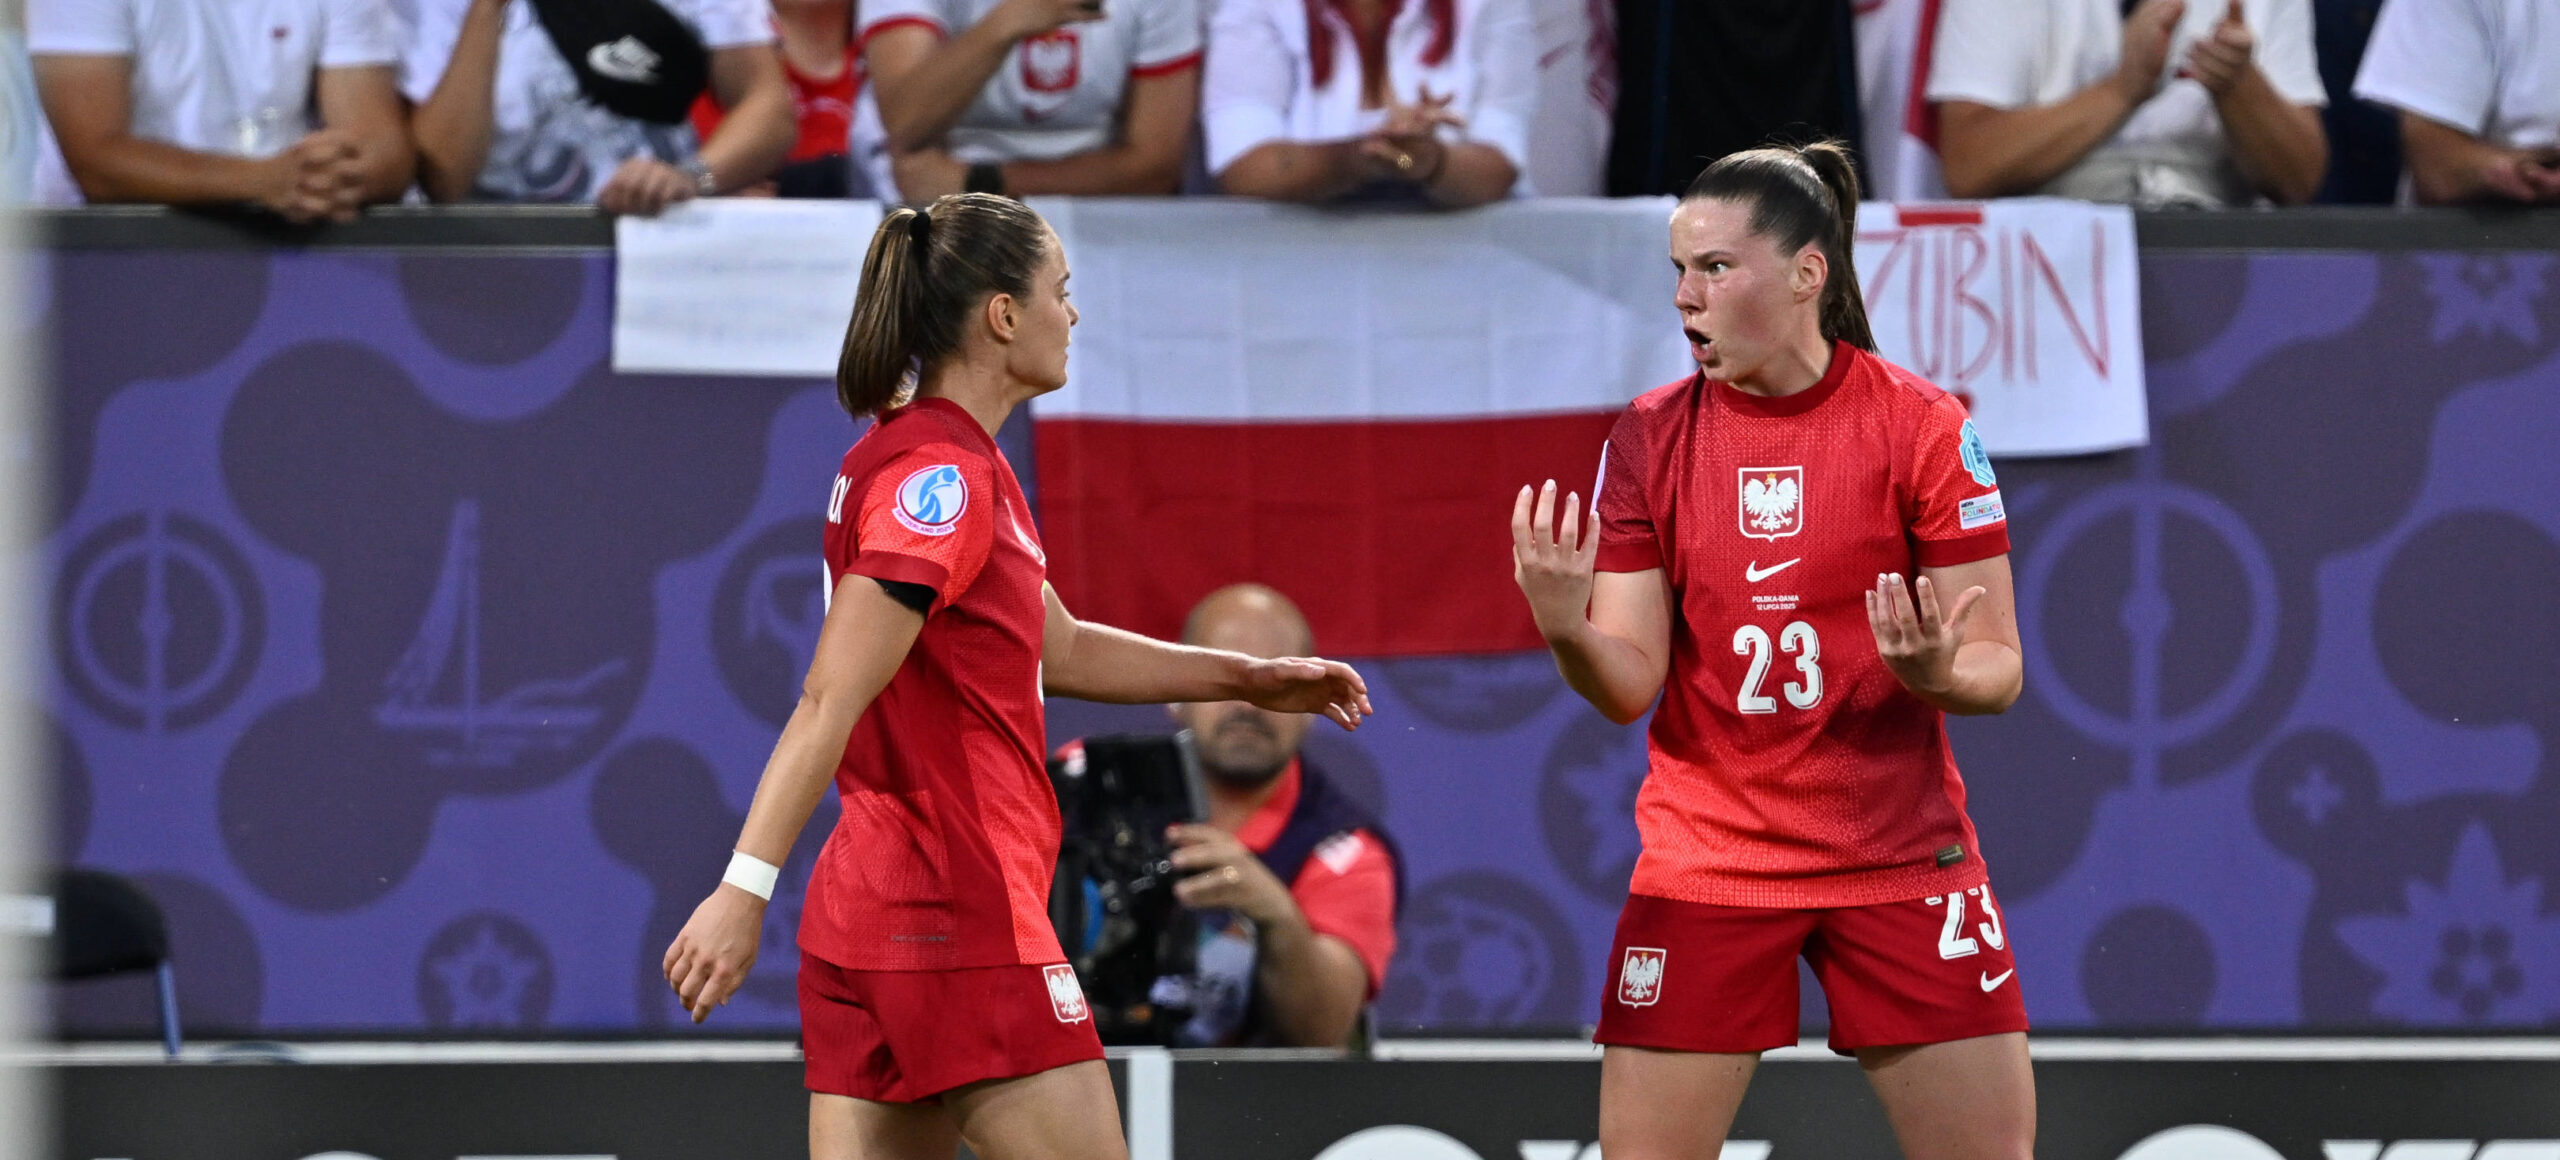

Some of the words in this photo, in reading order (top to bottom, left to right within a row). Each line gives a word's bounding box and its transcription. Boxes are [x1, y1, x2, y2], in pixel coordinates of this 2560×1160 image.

[936, 525, 952, 534] 2025
[1781, 602, 1796, 610] 2025
[1733, 620, 1824, 715] 23
[1925, 883, 2004, 960] 23
